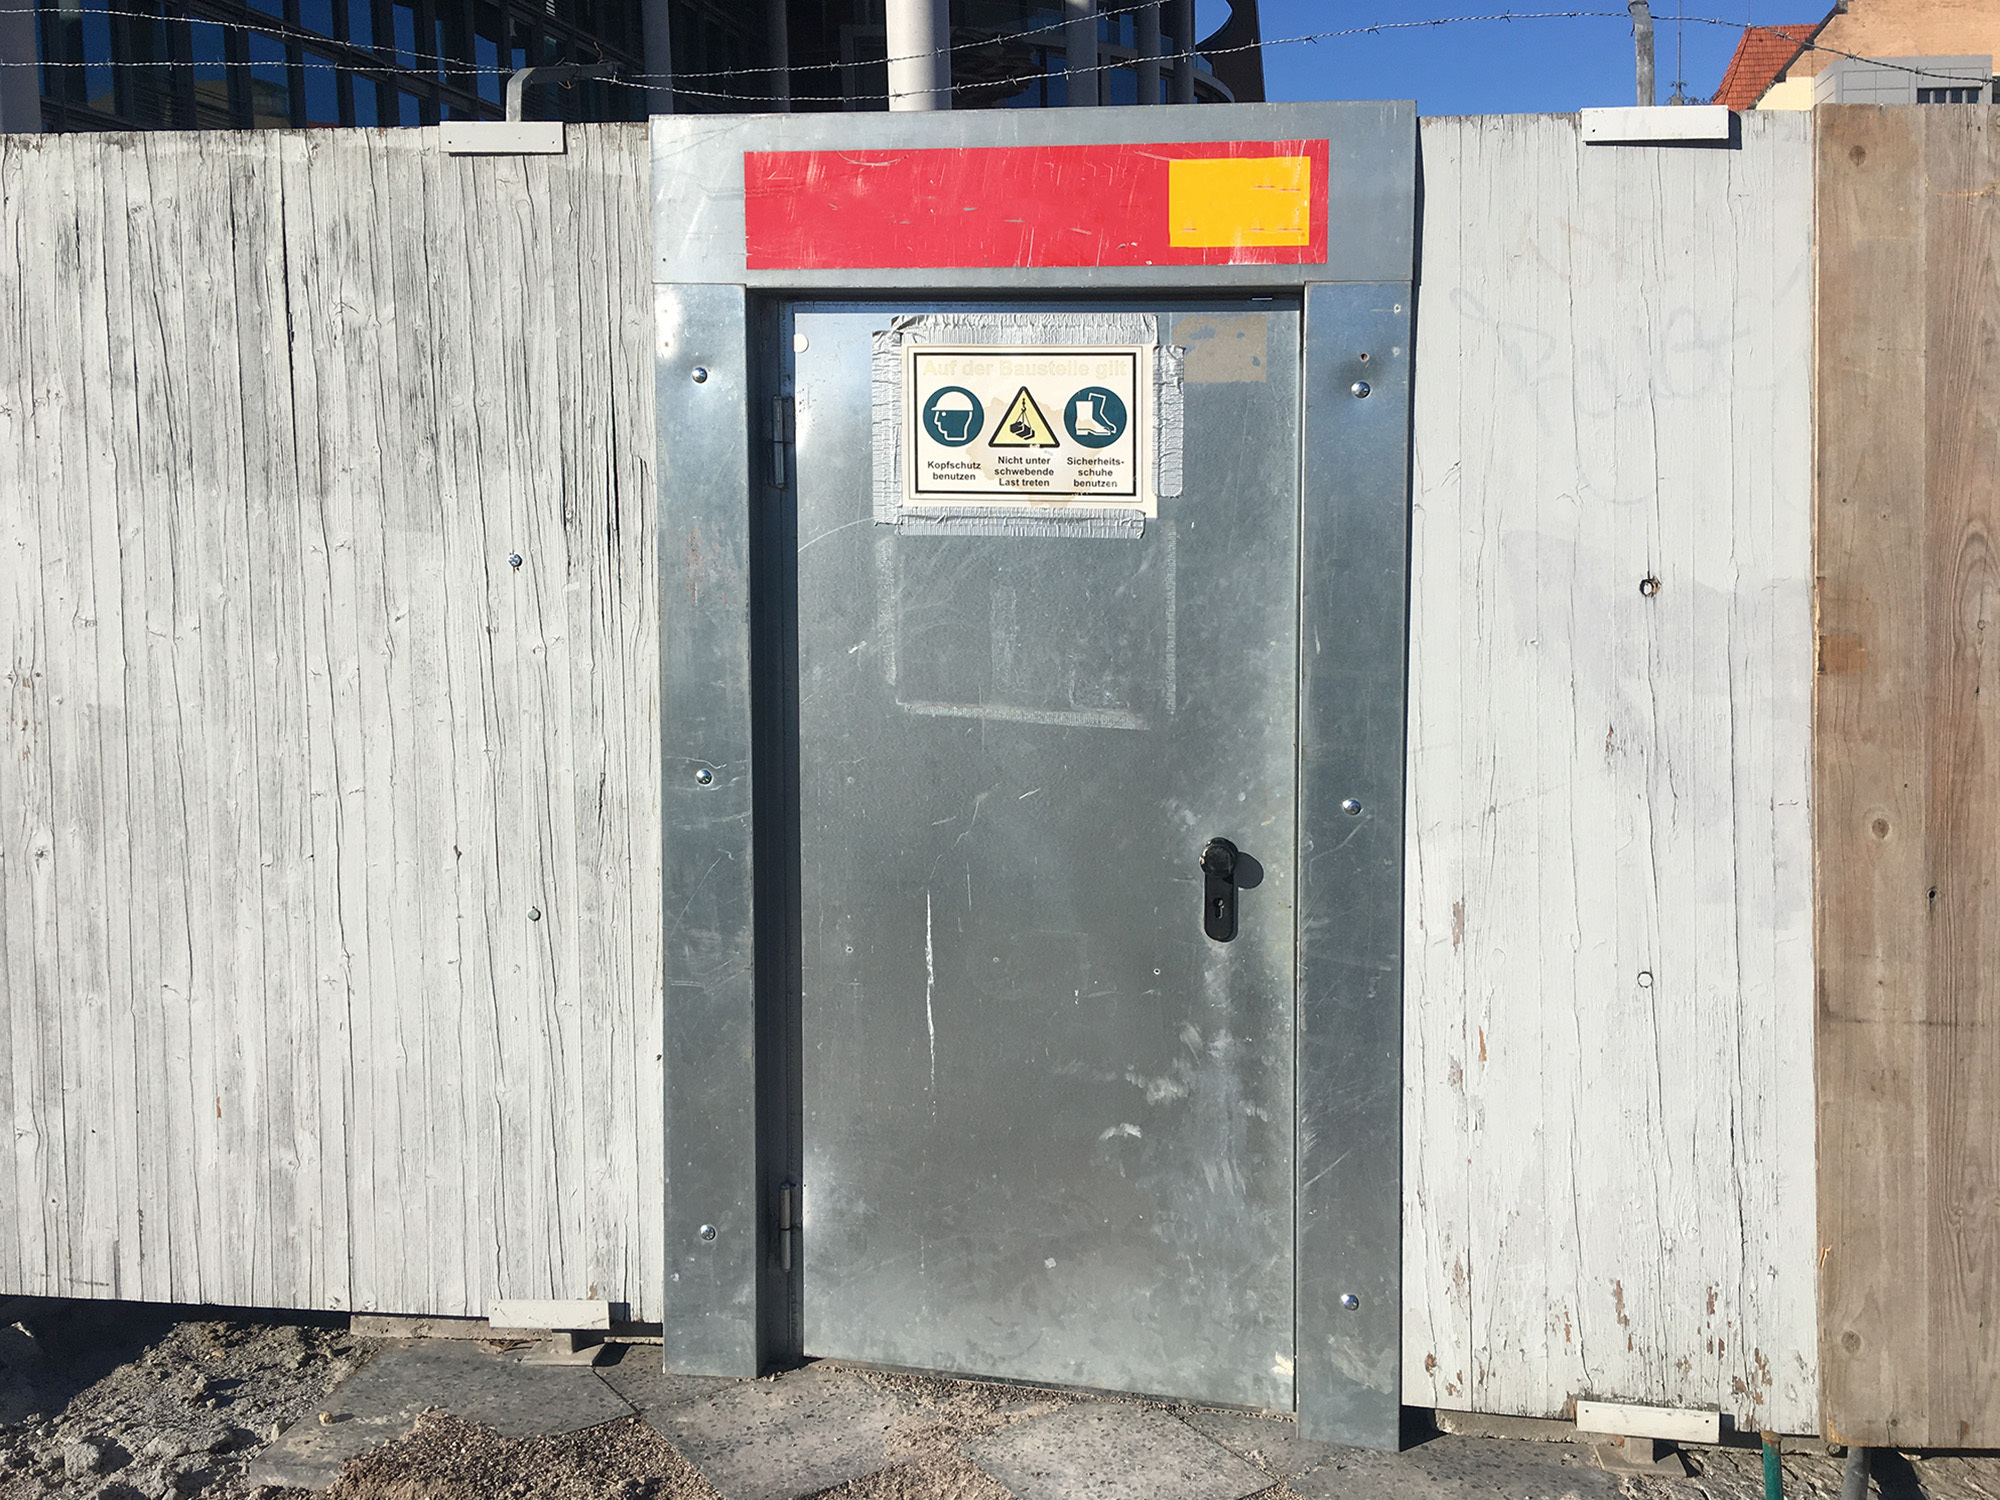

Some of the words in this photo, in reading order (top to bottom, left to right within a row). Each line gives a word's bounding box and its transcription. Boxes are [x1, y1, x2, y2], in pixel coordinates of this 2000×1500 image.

[923, 360, 957, 376] Auf
[962, 360, 993, 376] der
[999, 360, 1089, 377] Baustelle
[1096, 360, 1127, 379] gilt
[927, 460, 981, 470] Kopfschutz
[997, 456, 1024, 465] Nicht
[1025, 457, 1051, 465] unter
[1066, 456, 1124, 466] Sicherheits-
[932, 472, 976, 480] benutzen
[994, 467, 1055, 476] schwebende
[1078, 468, 1113, 477] schuhe
[998, 478, 1020, 487] Last
[1021, 478, 1050, 487] treten
[1073, 479, 1118, 488] benutzen
